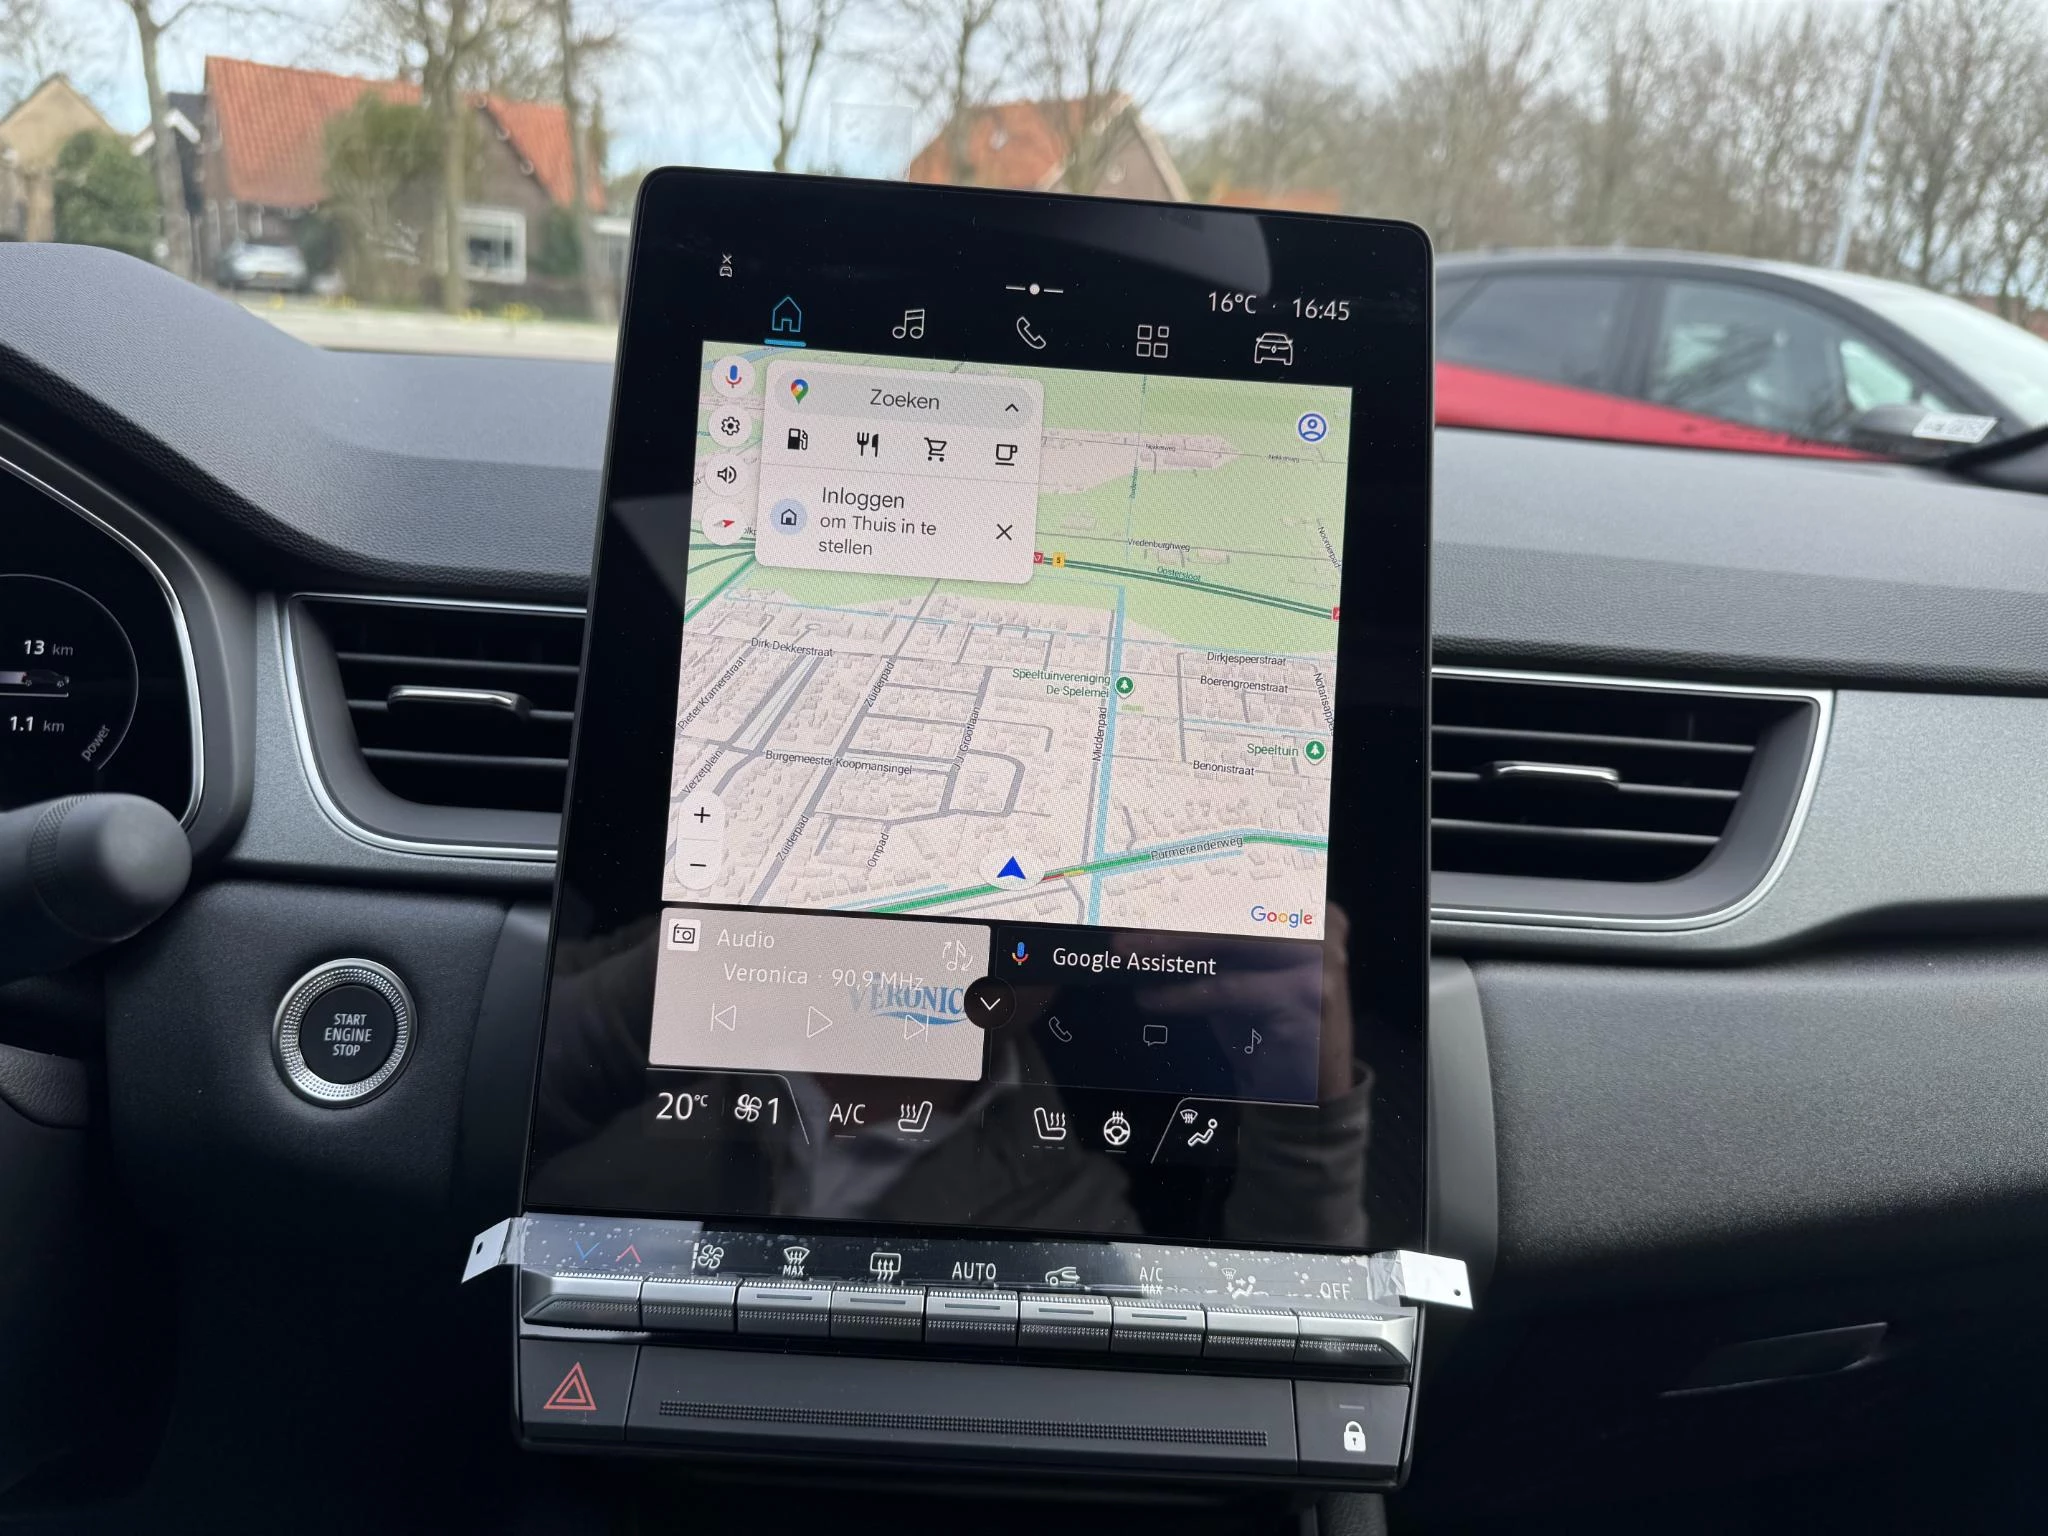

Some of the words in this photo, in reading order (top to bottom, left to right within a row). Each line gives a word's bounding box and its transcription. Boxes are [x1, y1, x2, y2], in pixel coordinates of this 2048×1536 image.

[1208, 291, 1257, 314] 16°C
[1292, 298, 1350, 321] 16:45
[870, 388, 940, 410] Zoeken
[821, 487, 905, 509] Inloggen
[820, 516, 846, 530] om
[853, 515, 896, 534] Thuis
[901, 520, 915, 535] in
[920, 521, 937, 536] te
[818, 539, 873, 556] stellen
[1127, 538, 1190, 552] Vredenburghweg
[1317, 526, 1341, 569] Noorderpad
[23, 639, 45, 655] 13
[52, 643, 74, 656] km
[751, 637, 771, 649] Dirk
[772, 641, 833, 657] Dekkerstraat
[1207, 652, 1286, 666] Dirkjespeerstraat
[864, 660, 895, 708] Zuiderpad
[1012, 668, 1110, 687] Speeltuinvereniging
[1200, 675, 1288, 694] Boerengroenstraat
[677, 704, 703, 731] Pieter
[699, 656, 747, 708] Kramerstraat
[1046, 685, 1060, 695] De
[1062, 686, 1109, 698] Spelemei
[1313, 672, 1334, 737] Notarisappe
[9, 715, 34, 732] 1.1
[43, 719, 65, 733] km
[960, 706, 981, 752] Grootlaan
[1092, 706, 1107, 761] Middenpad
[81, 724, 111, 761] power
[1247, 743, 1299, 757] Speeltuin
[681, 750, 724, 795] Verzetplein
[765, 750, 833, 766] Burgemeester
[836, 758, 912, 776] Koopmansingel
[1193, 760, 1255, 776] Benonistraat
[776, 815, 809, 862] Zuiderpad
[1151, 836, 1243, 861] Purmerenderweg
[867, 832, 889, 868] Ompad
[1250, 905, 1313, 928] Google
[716, 928, 774, 949] Audio
[1053, 947, 1122, 972] Google
[1127, 952, 1217, 975] Assistent
[724, 963, 808, 985] Veronica
[831, 968, 874, 991] 90,9
[880, 971, 924, 991] MHz
[333, 1013, 367, 1026] START
[324, 1027, 372, 1042] ENGINE
[332, 1043, 361, 1056] STOP
[656, 1092, 709, 1121] 20°C
[767, 1097, 779, 1125] 1
[829, 1103, 866, 1126] A/C
[783, 1264, 805, 1277] MAX
[952, 1261, 996, 1281] AUTO
[1139, 1266, 1163, 1283] A/C
[1140, 1284, 1163, 1296] MAX
[1321, 1281, 1351, 1300] OFF
